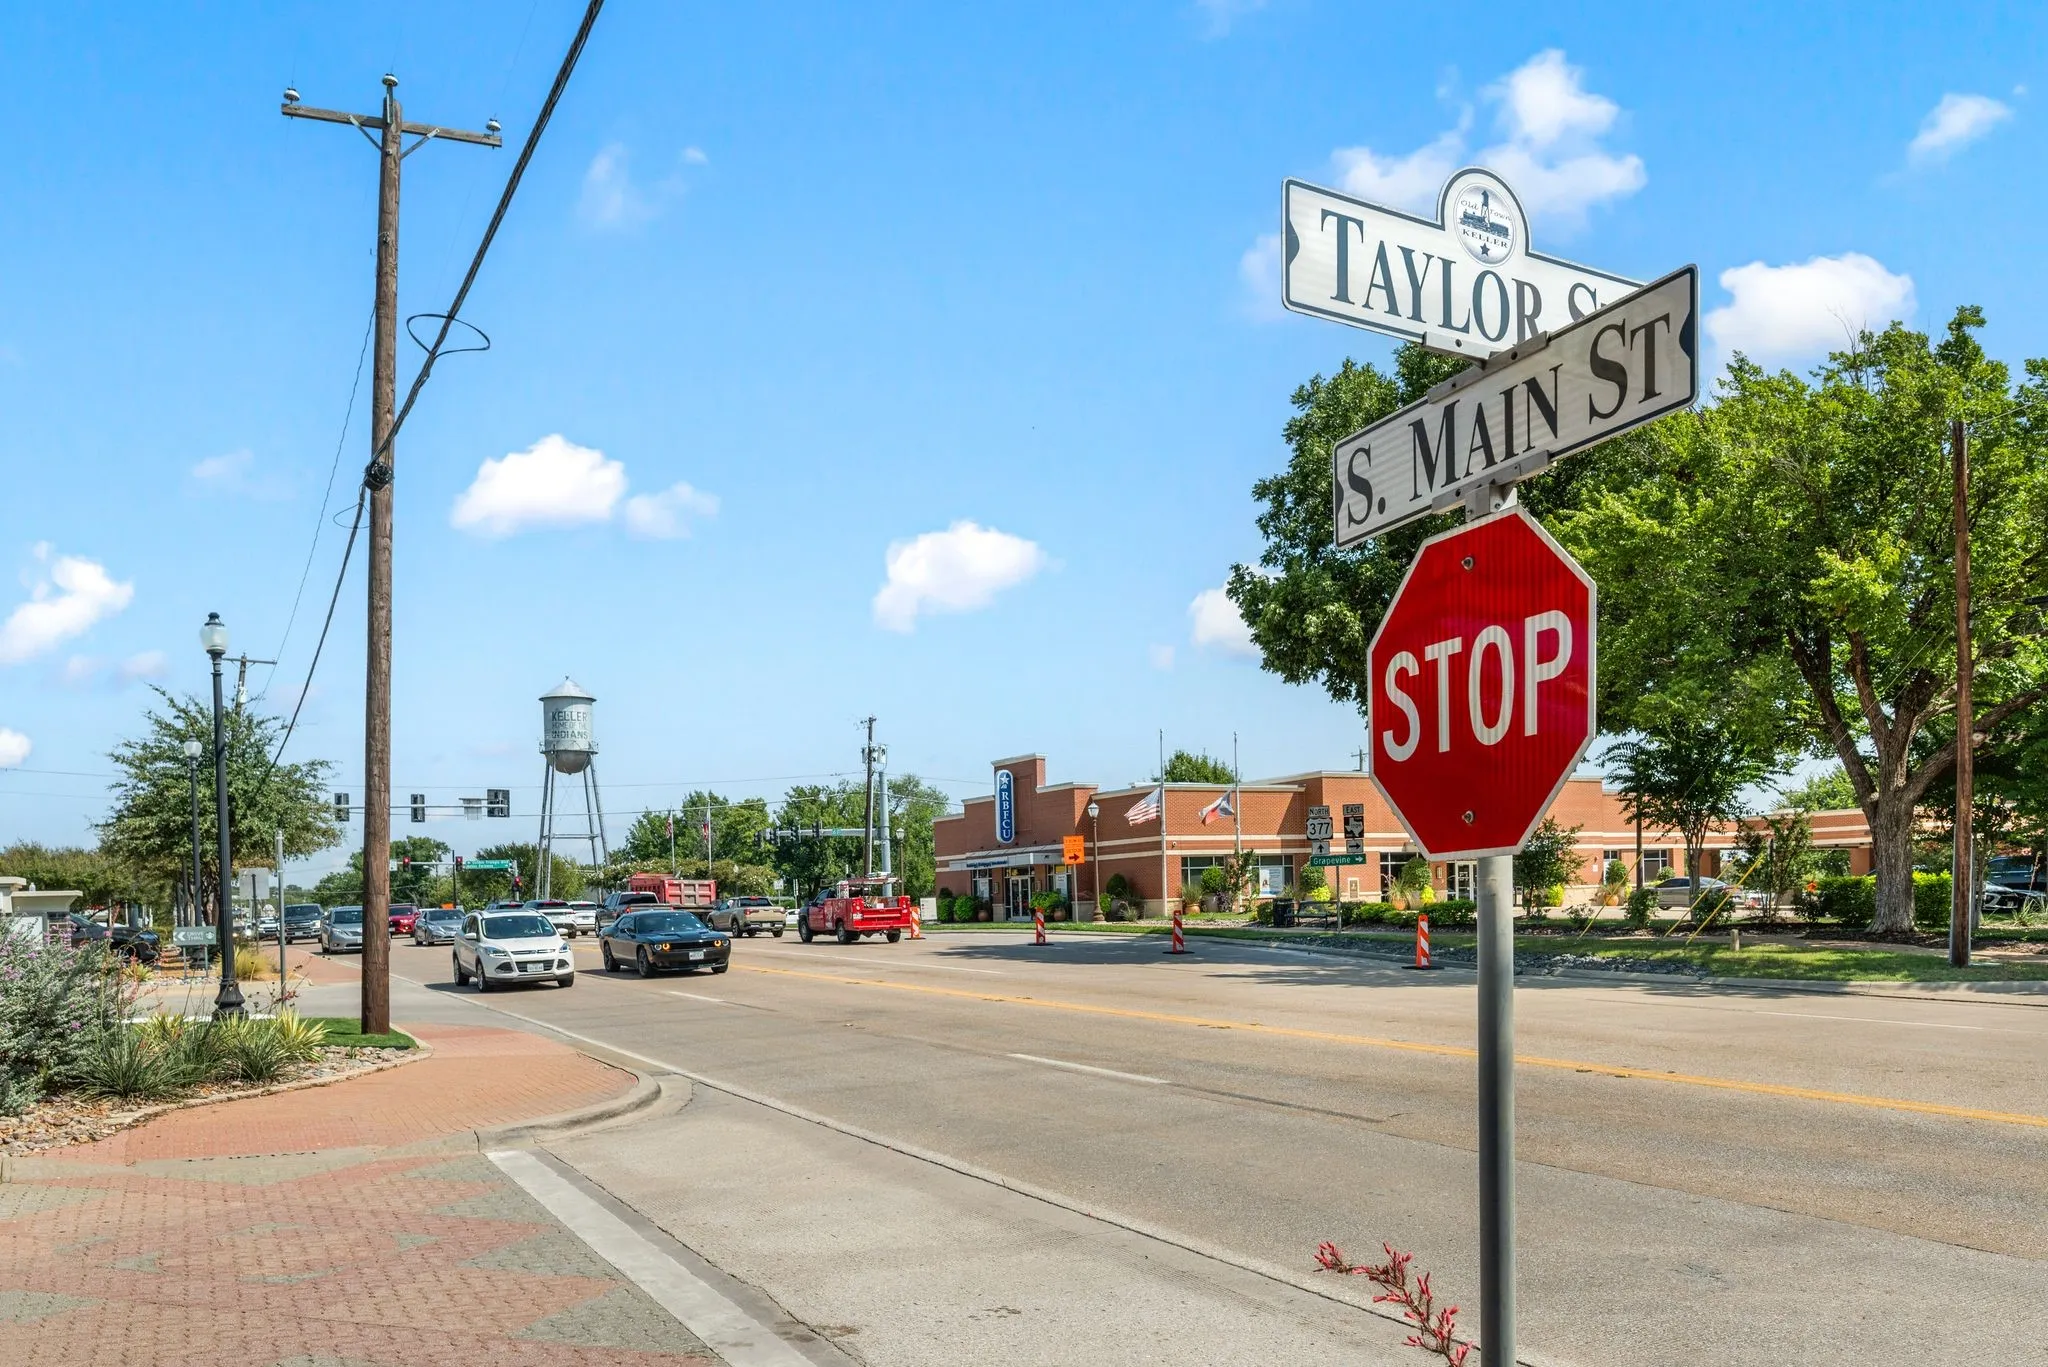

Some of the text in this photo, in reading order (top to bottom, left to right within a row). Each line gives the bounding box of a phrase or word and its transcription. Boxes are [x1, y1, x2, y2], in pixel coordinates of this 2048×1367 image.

[1460, 199, 1513, 222] Old Town
[1462, 228, 1508, 249] KELLER
[1320, 208, 1543, 345] TAYLOR
[1347, 312, 1670, 529] S. MAIN ST
[1382, 609, 1573, 762] STOP
[551, 711, 588, 721] KELLER
[552, 730, 589, 739] INDIANS
[1001, 791, 1011, 839] RBFCU
[1309, 808, 1329, 816] NORTH
[1346, 806, 1361, 814] EAST
[1309, 822, 1330, 835] 377
[1313, 857, 1351, 865] Grapevine
